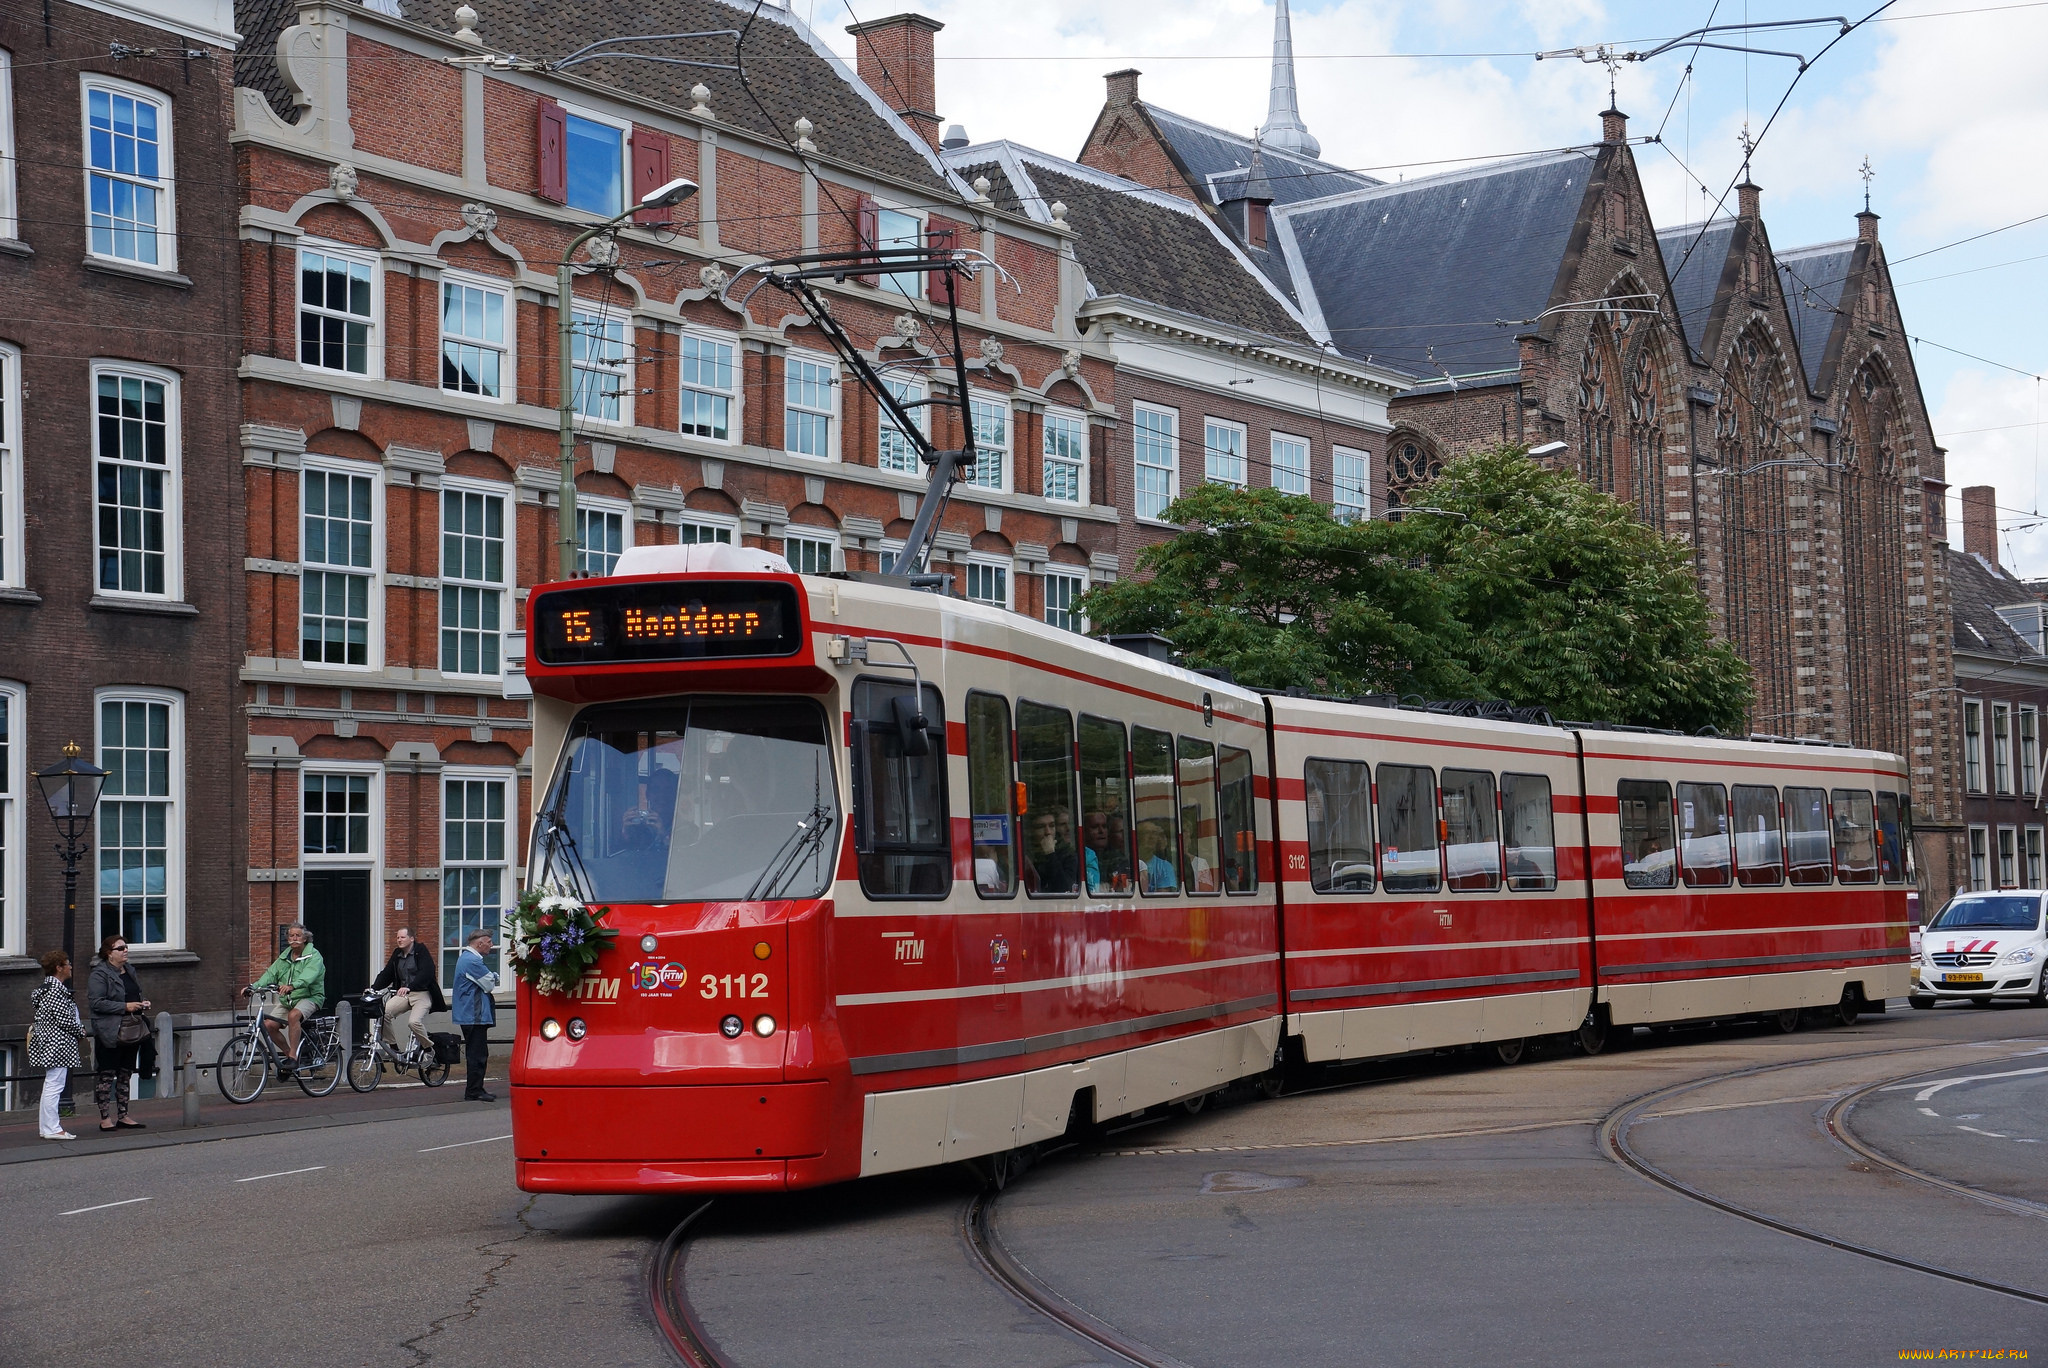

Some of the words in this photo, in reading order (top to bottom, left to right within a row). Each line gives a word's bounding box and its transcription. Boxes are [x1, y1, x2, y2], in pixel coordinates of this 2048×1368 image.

[562, 611, 591, 642] 15
[626, 606, 759, 638] Nootdorp
[1288, 854, 1306, 870] 3112
[1439, 914, 1453, 926] HTM
[894, 939, 925, 960] HTM
[663, 972, 684, 980] HTM
[700, 972, 769, 1000] 3112
[566, 977, 621, 999] HTM
